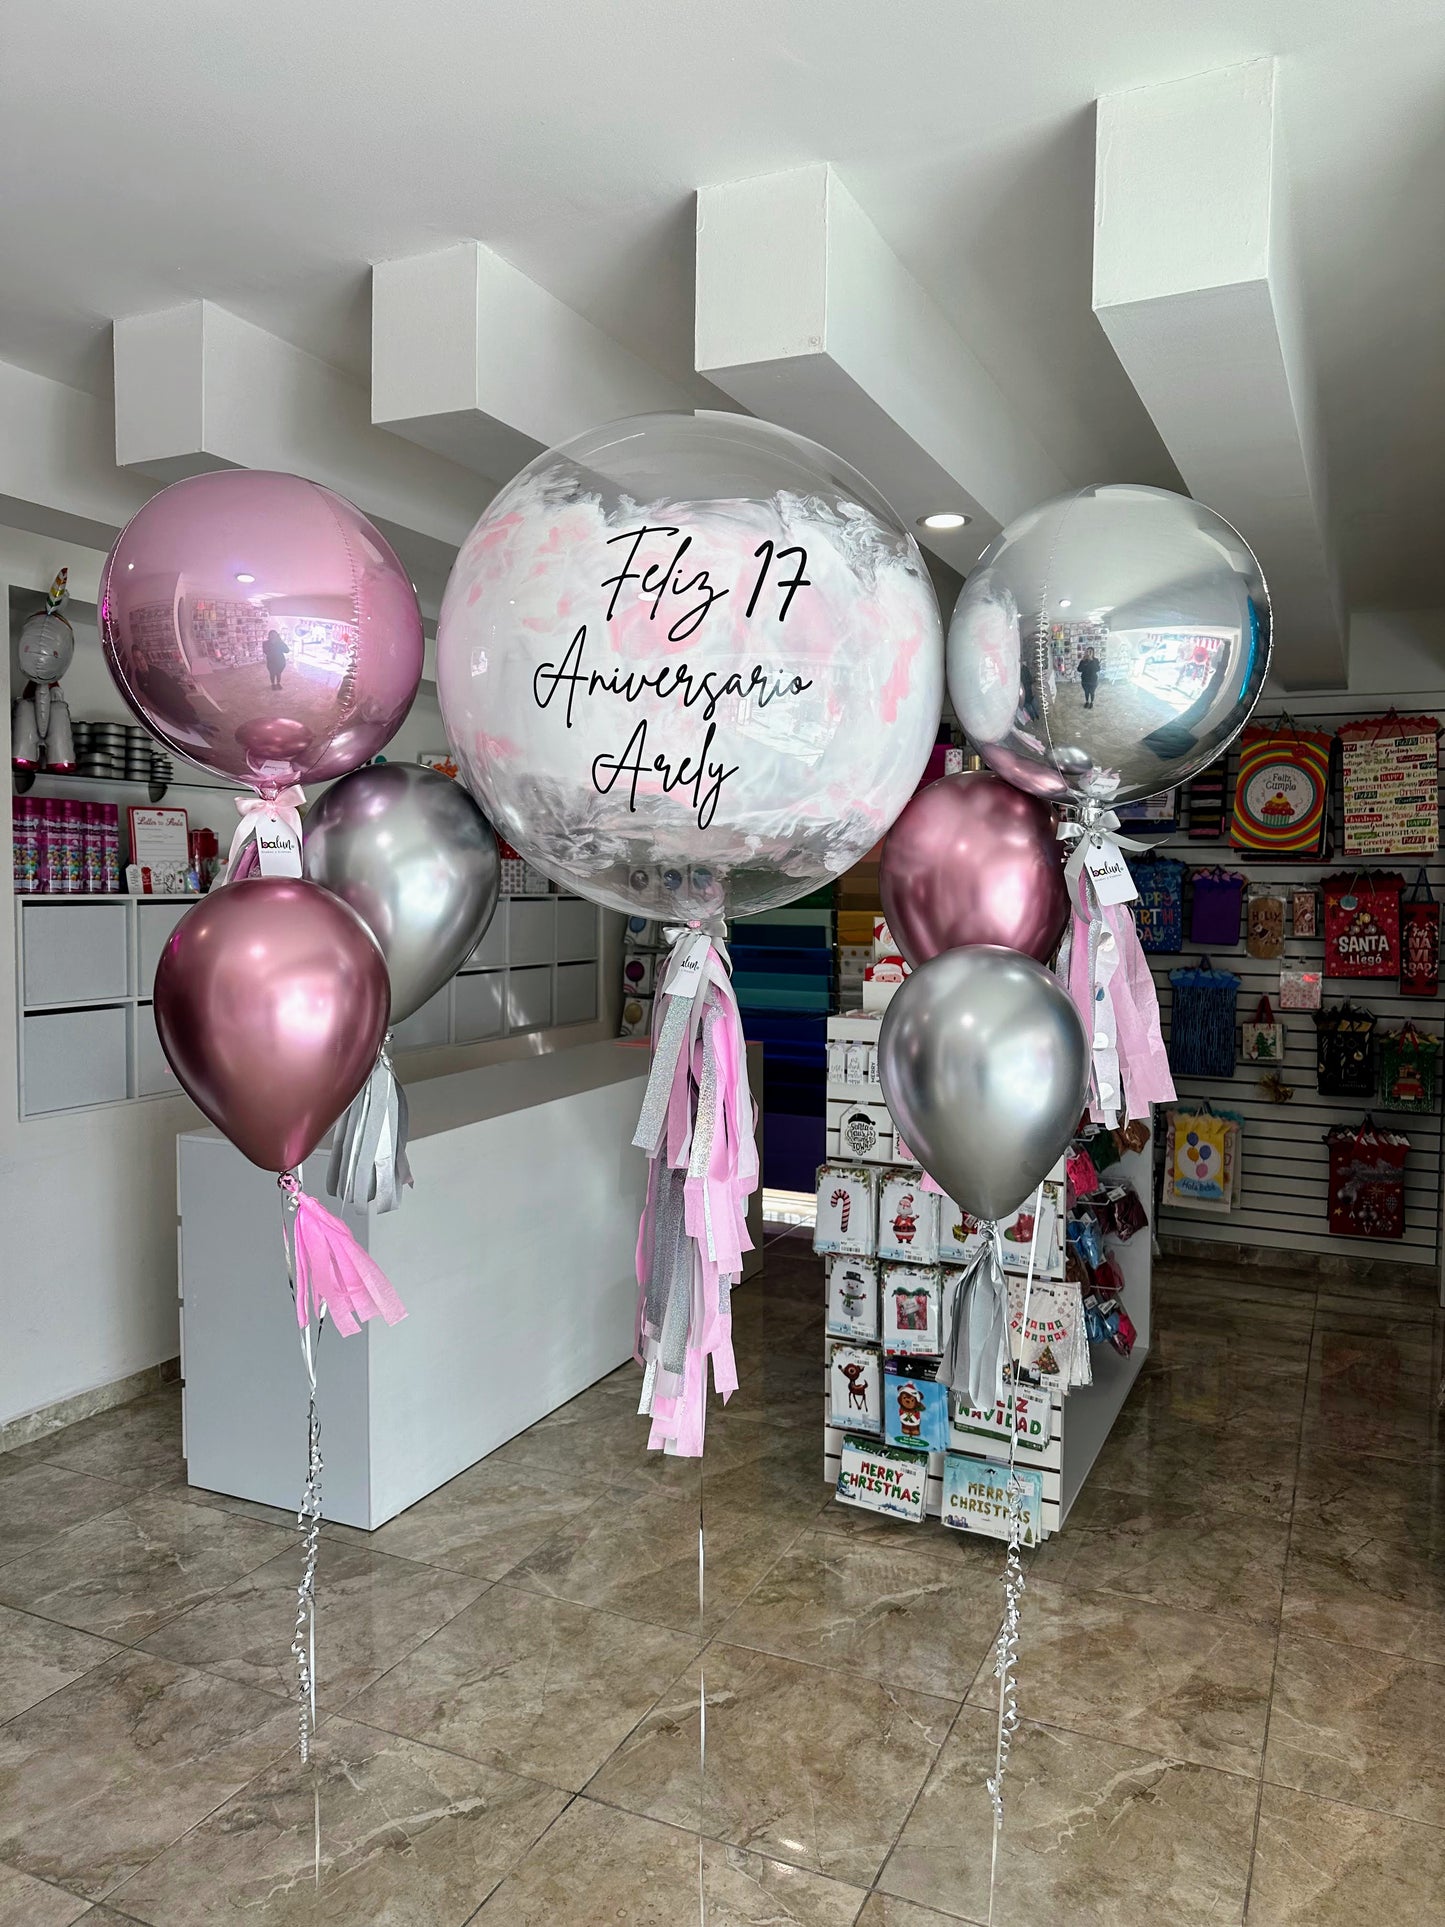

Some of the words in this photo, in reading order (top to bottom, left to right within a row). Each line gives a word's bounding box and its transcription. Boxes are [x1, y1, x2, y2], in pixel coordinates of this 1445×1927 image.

[600, 525, 729, 642] Feliz
[745, 540, 811, 622] 17
[533, 625, 813, 728] Aniversario
[591, 719, 740, 831] Arely
[1130, 891, 1174, 907] APPY
[1136, 908, 1174, 925] RTH
[1338, 935, 1390, 953] SANTA
[680, 955, 697, 971] lun
[1349, 953, 1382, 966] Llegó
[996, 1394, 1029, 1414] LIZ
[860, 1460, 904, 1485] MERRY
[840, 1471, 920, 1505] CHRISTMAS
[968, 1481, 1015, 1504] MERRY
